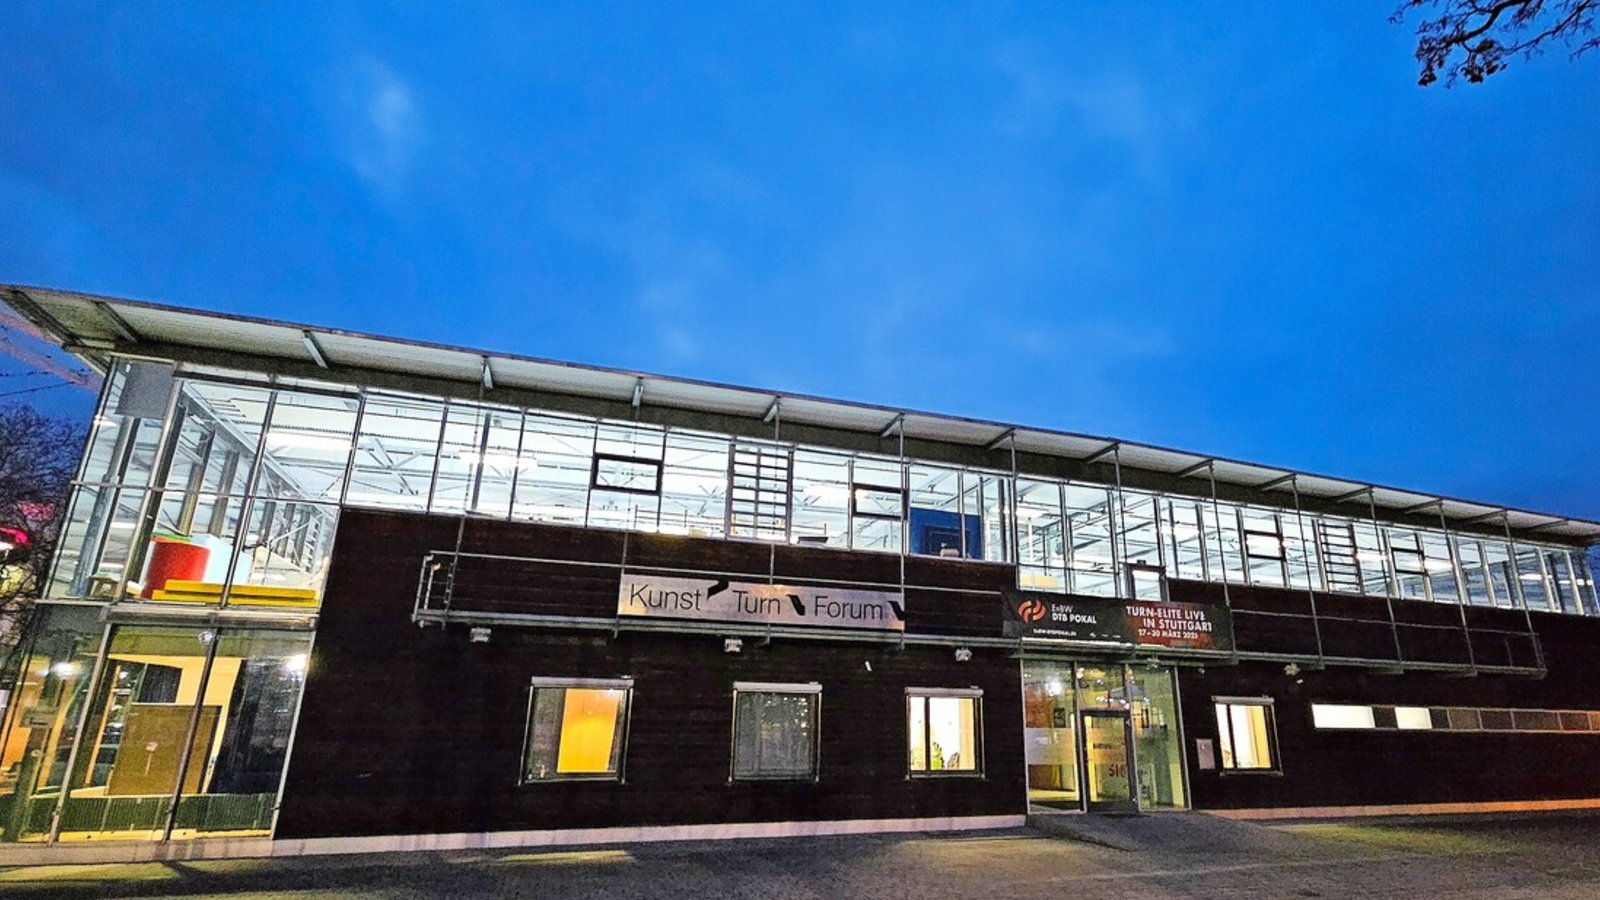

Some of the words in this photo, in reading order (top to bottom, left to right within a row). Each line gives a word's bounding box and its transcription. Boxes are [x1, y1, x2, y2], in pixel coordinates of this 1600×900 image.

[630, 583, 701, 611] Kunst
[733, 590, 780, 614] Turn
[815, 596, 883, 620] Forum
[1052, 612, 1068, 622] DTB
[1069, 614, 1097, 624] POKAL
[1126, 606, 1181, 619] TURN-ELITE
[1185, 610, 1205, 620] LIVE
[1143, 618, 1155, 628] IN
[1159, 620, 1212, 632] STUTTGART
